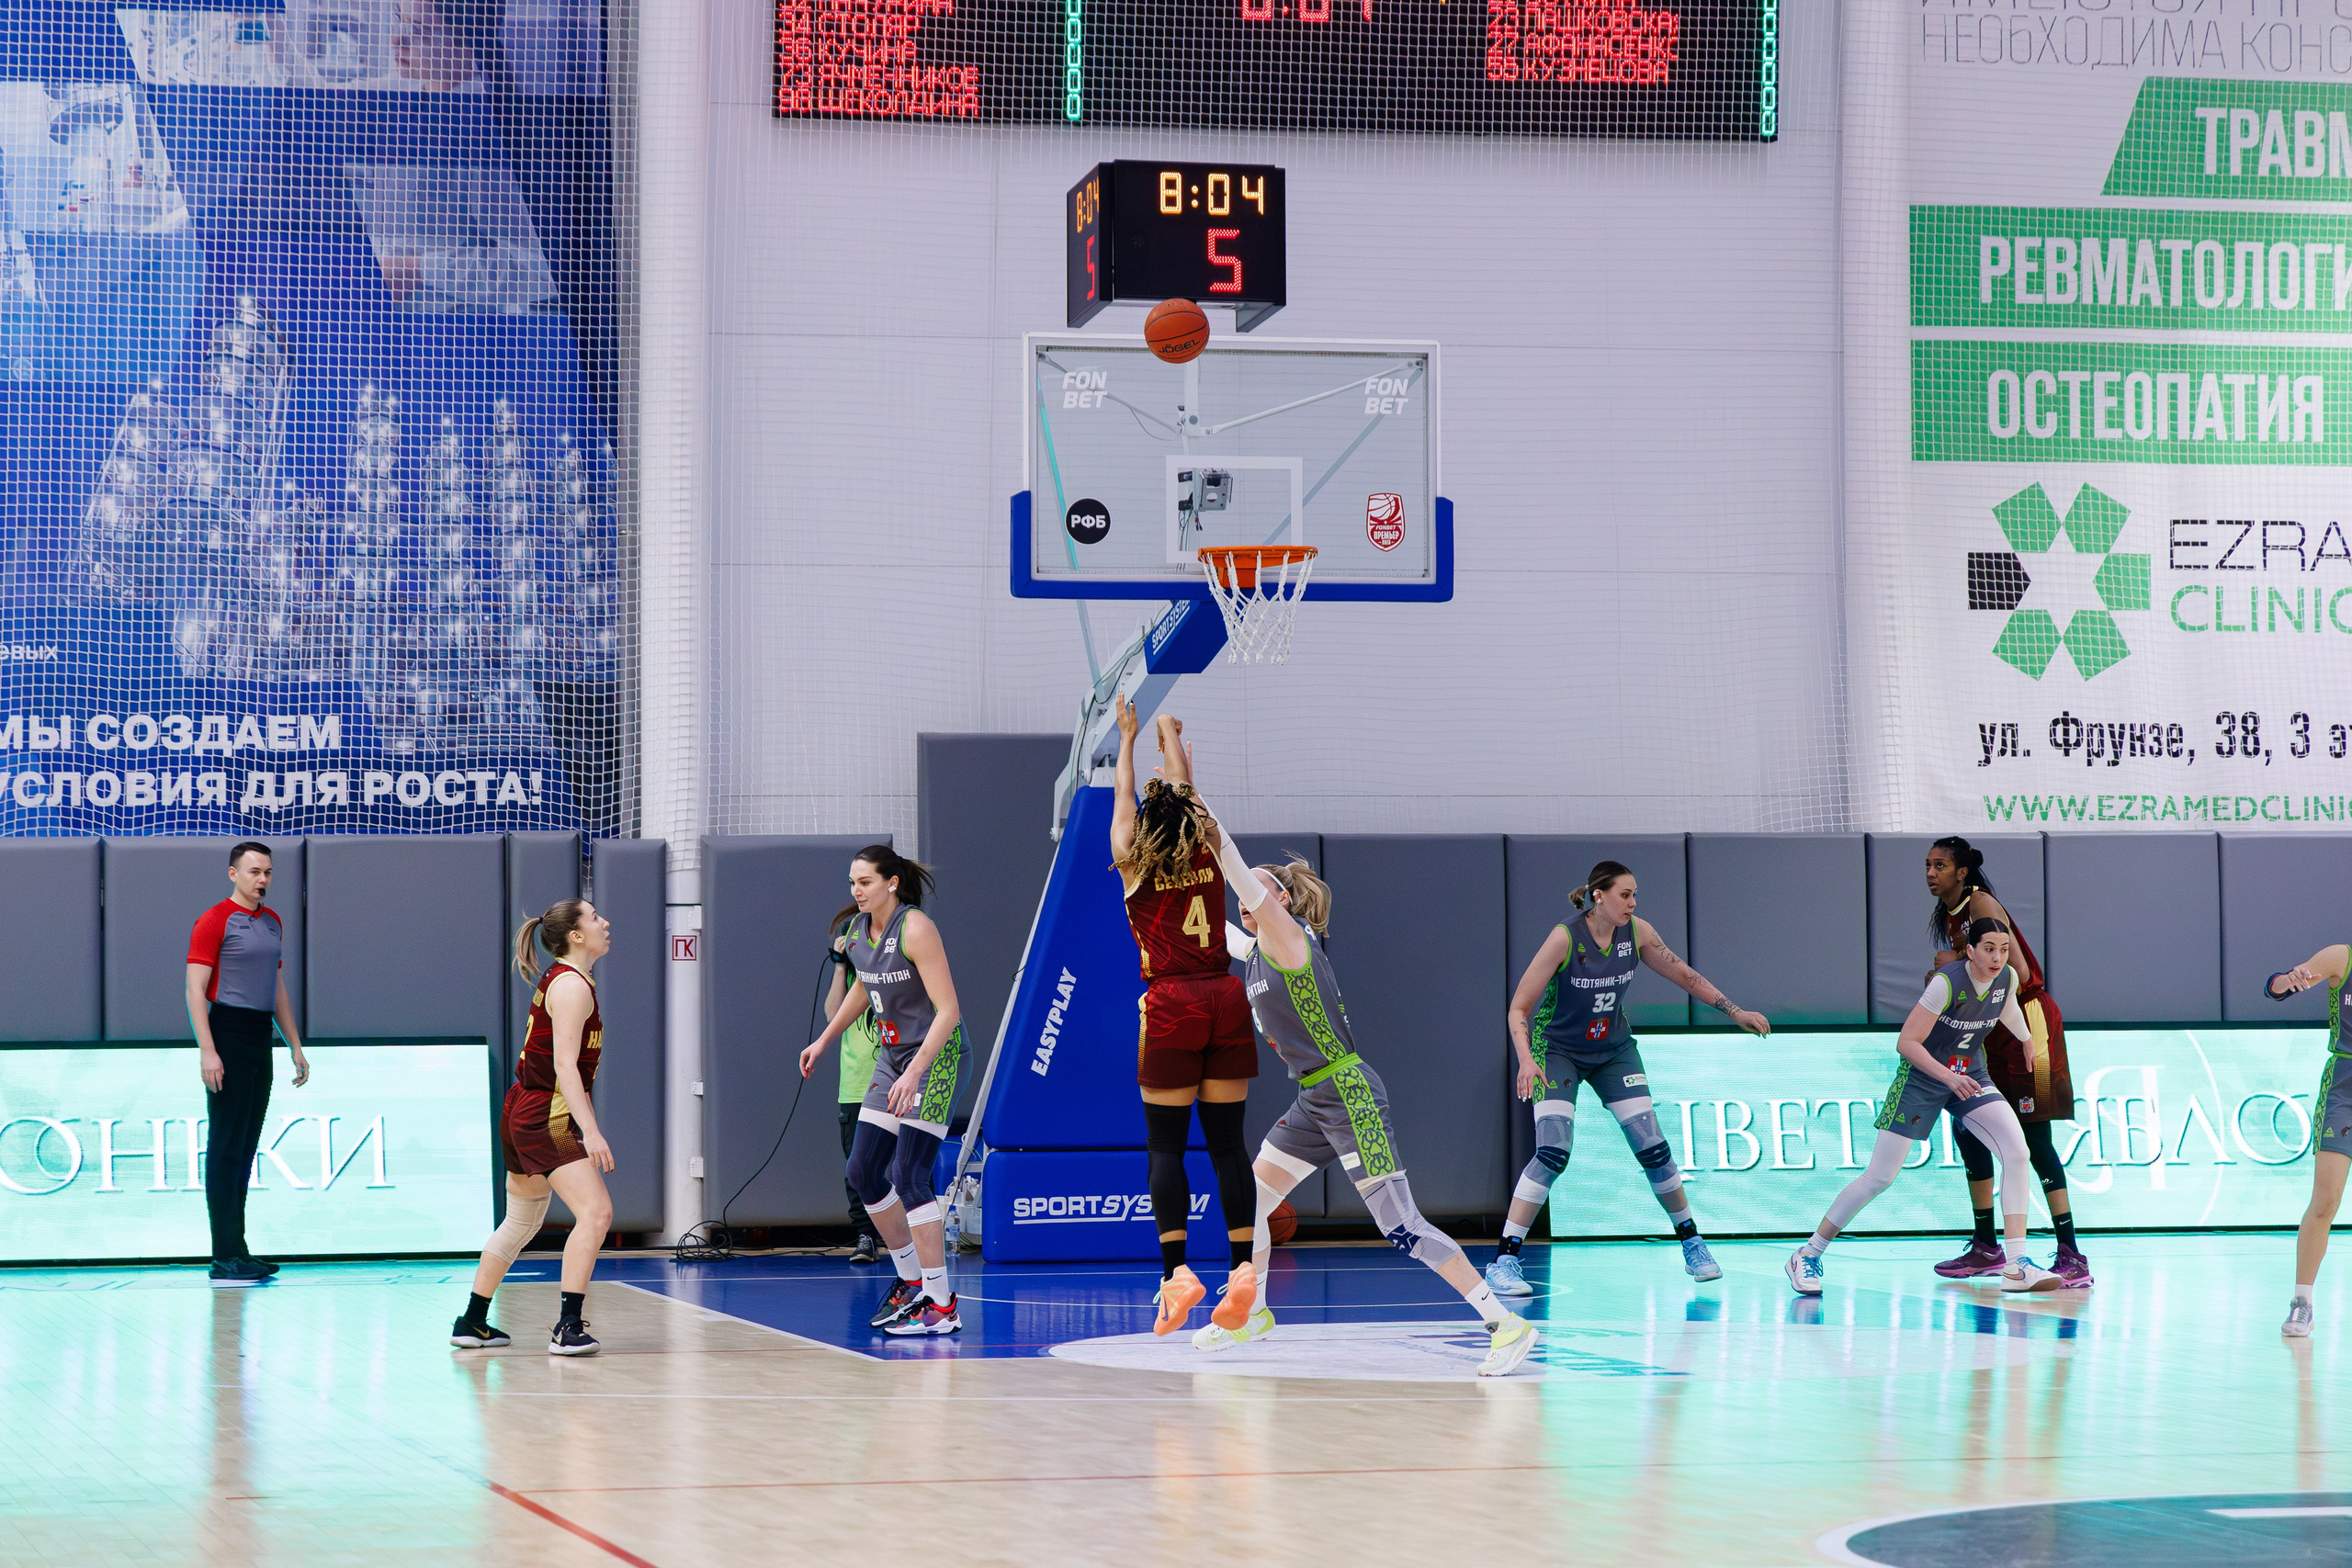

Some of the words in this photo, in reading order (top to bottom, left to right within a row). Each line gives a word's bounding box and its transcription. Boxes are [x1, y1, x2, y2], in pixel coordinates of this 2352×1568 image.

[1923, 13, 2226, 71] НЕОБХОДИМА
[2241, 21, 2352, 74] КОНС
[1076, 175, 1100, 234] 8:04
[1159, 171, 1264, 216] 8:04
[1086, 234, 1095, 301] 5
[1207, 228, 1242, 292] 5
[1158, 338, 1201, 354] JÖGEL
[1062, 371, 1108, 389] FON
[1364, 378, 1409, 396] FON
[1062, 390, 1108, 409] BET
[1364, 397, 1409, 414] BET
[1987, 369, 2324, 444] ОСТЕОПАТИЯ
[1070, 513, 1106, 529] РФБ
[2169, 518, 2352, 571] EZRA
[86, 714, 342, 756] СОЗДАЕМ
[1977, 722, 2030, 767] ул.
[2049, 710, 2196, 767] Фрунзе,
[2215, 710, 2273, 767] 38,
[2290, 710, 2311, 759] 3
[2328, 723, 2352, 759] э
[240, 772, 347, 813] ДЛЯ
[364, 771, 542, 807] РОСТА!
[1982, 794, 2352, 822] WWW.EZRAMEDCLINI
[1182, 895, 1211, 948] 4
[675, 938, 695, 958] ПК
[1617, 941, 1632, 951] FON
[1618, 948, 1633, 957] BET
[856, 968, 911, 985] ТЯНИК-ТИТАН
[1592, 991, 1617, 1013] 32
[1030, 966, 1077, 1077] EASYPLAY
[1957, 1032, 1975, 1049] 2
[0, 1112, 396, 1195] ОНКИ
[1013, 1193, 1211, 1219] SPORTSYSM
